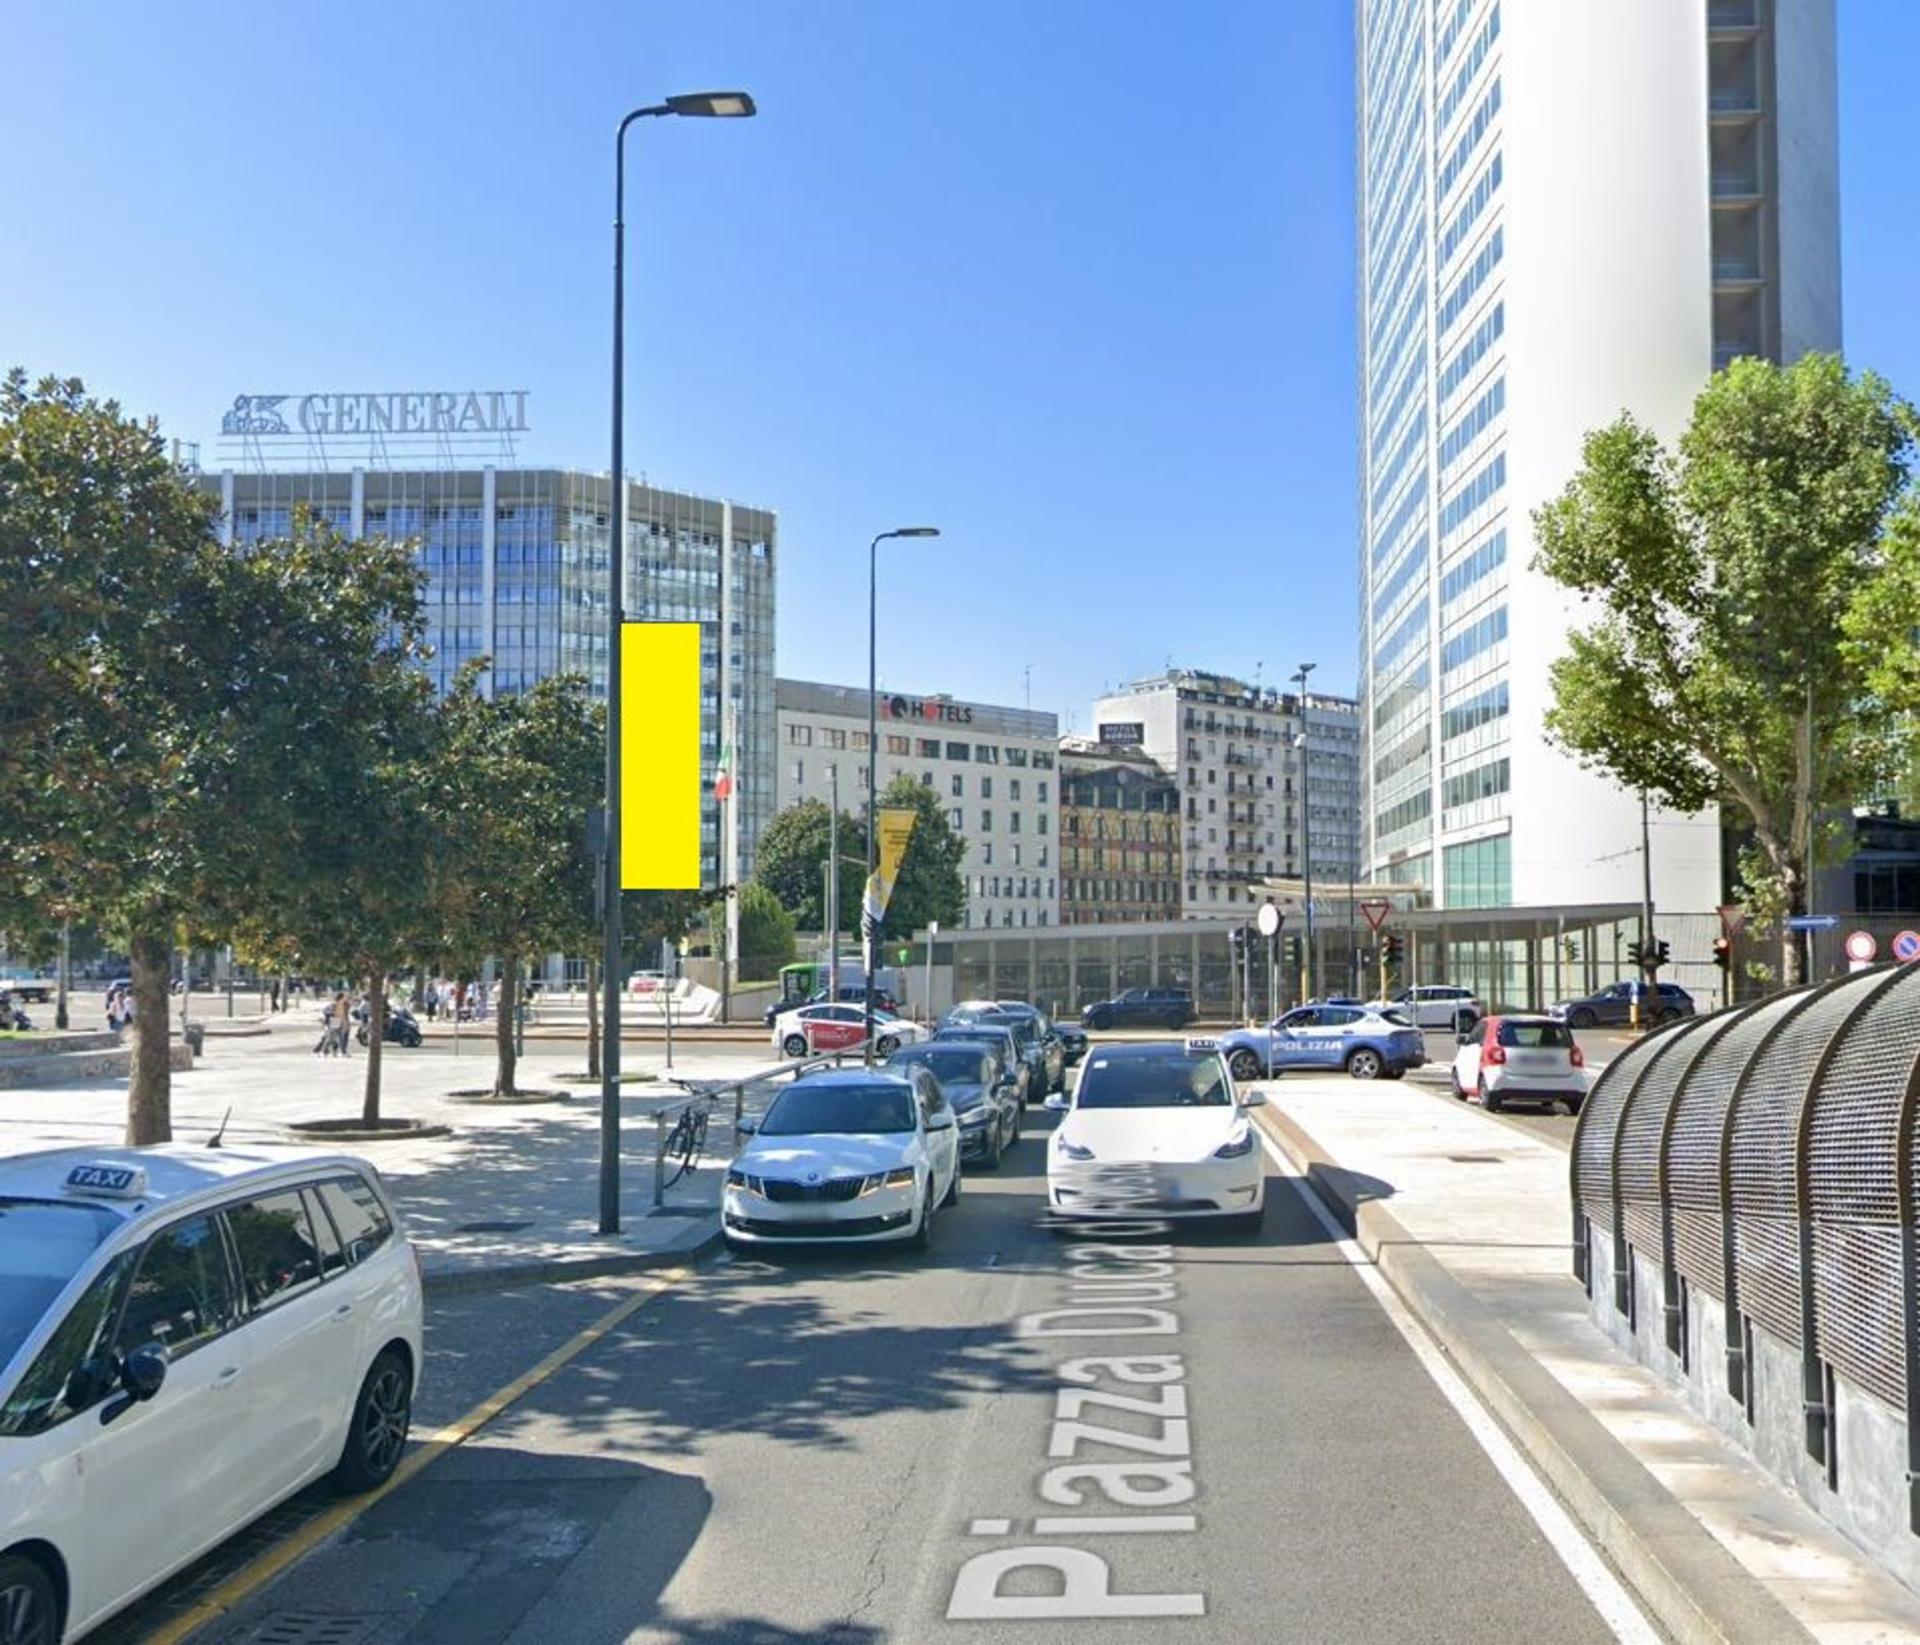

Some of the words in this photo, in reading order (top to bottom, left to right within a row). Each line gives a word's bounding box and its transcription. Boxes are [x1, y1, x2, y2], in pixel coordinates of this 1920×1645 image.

[299, 392, 530, 434] GENERALI
[911, 700, 973, 724] HOTELS
[1272, 1040, 1344, 1051] POLIZIA
[75, 1168, 130, 1186] TAXI
